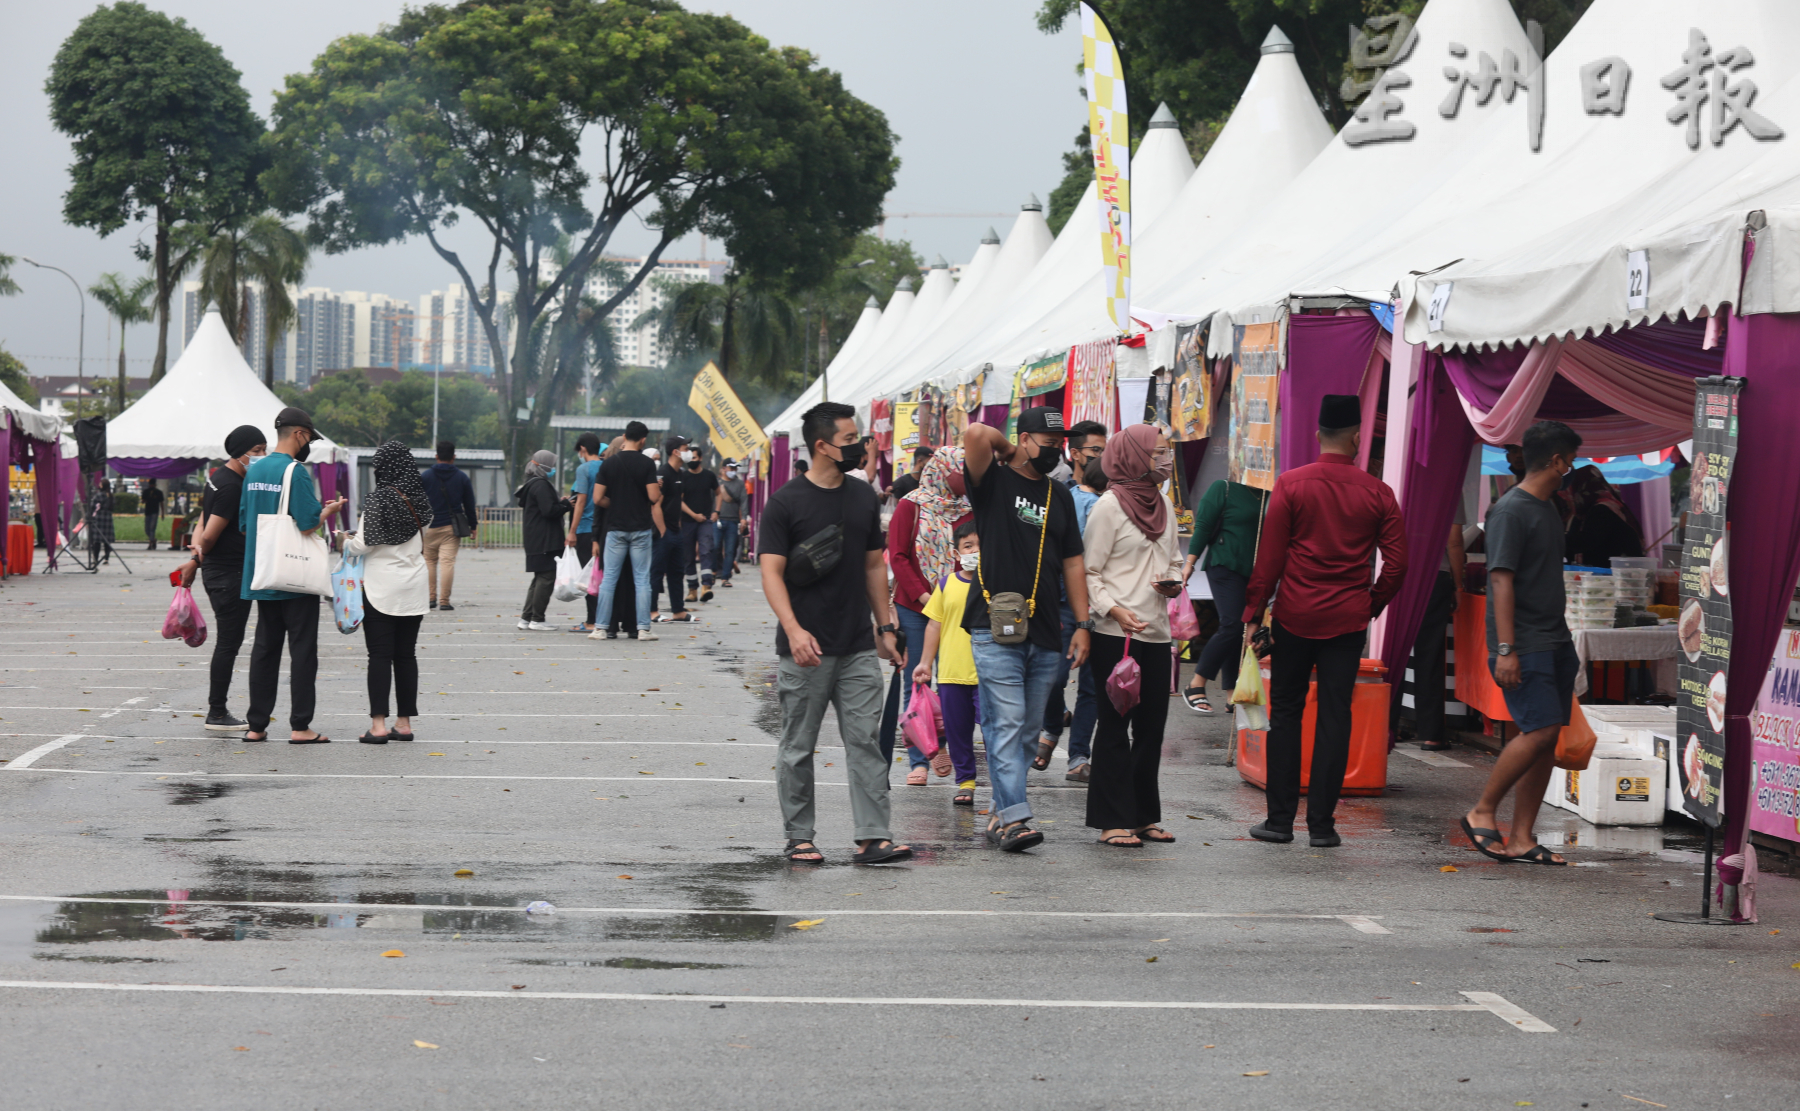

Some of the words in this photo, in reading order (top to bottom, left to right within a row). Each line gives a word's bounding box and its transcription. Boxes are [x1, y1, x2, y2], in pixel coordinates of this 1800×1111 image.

[1630, 268, 1642, 297] 22
[1429, 298, 1442, 321] 21
[247, 482, 282, 492] ALENCAGA
[1755, 713, 1792, 748] BLACK
